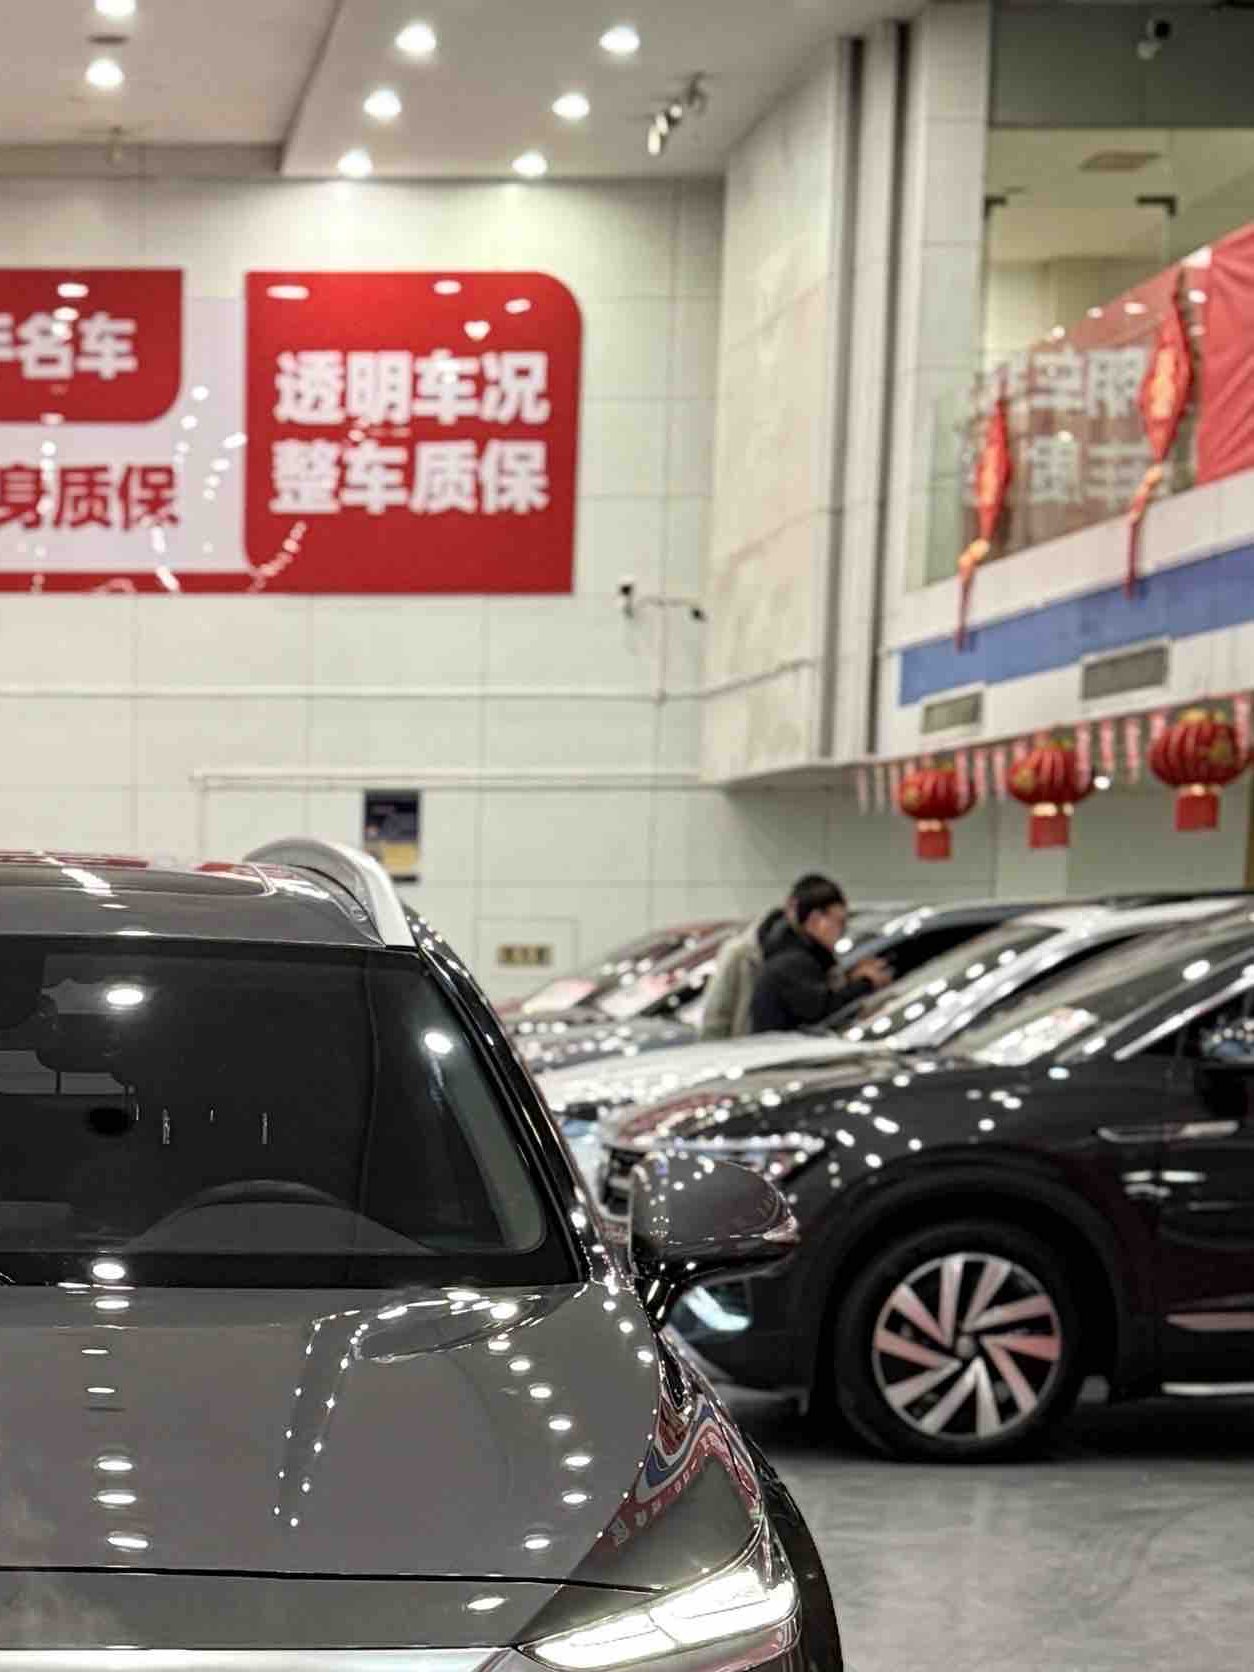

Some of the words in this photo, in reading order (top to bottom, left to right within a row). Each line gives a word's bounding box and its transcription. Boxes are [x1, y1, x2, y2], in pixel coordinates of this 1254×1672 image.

[273, 350, 550, 426] 透明车况
[268, 440, 549, 516] 整车质保
